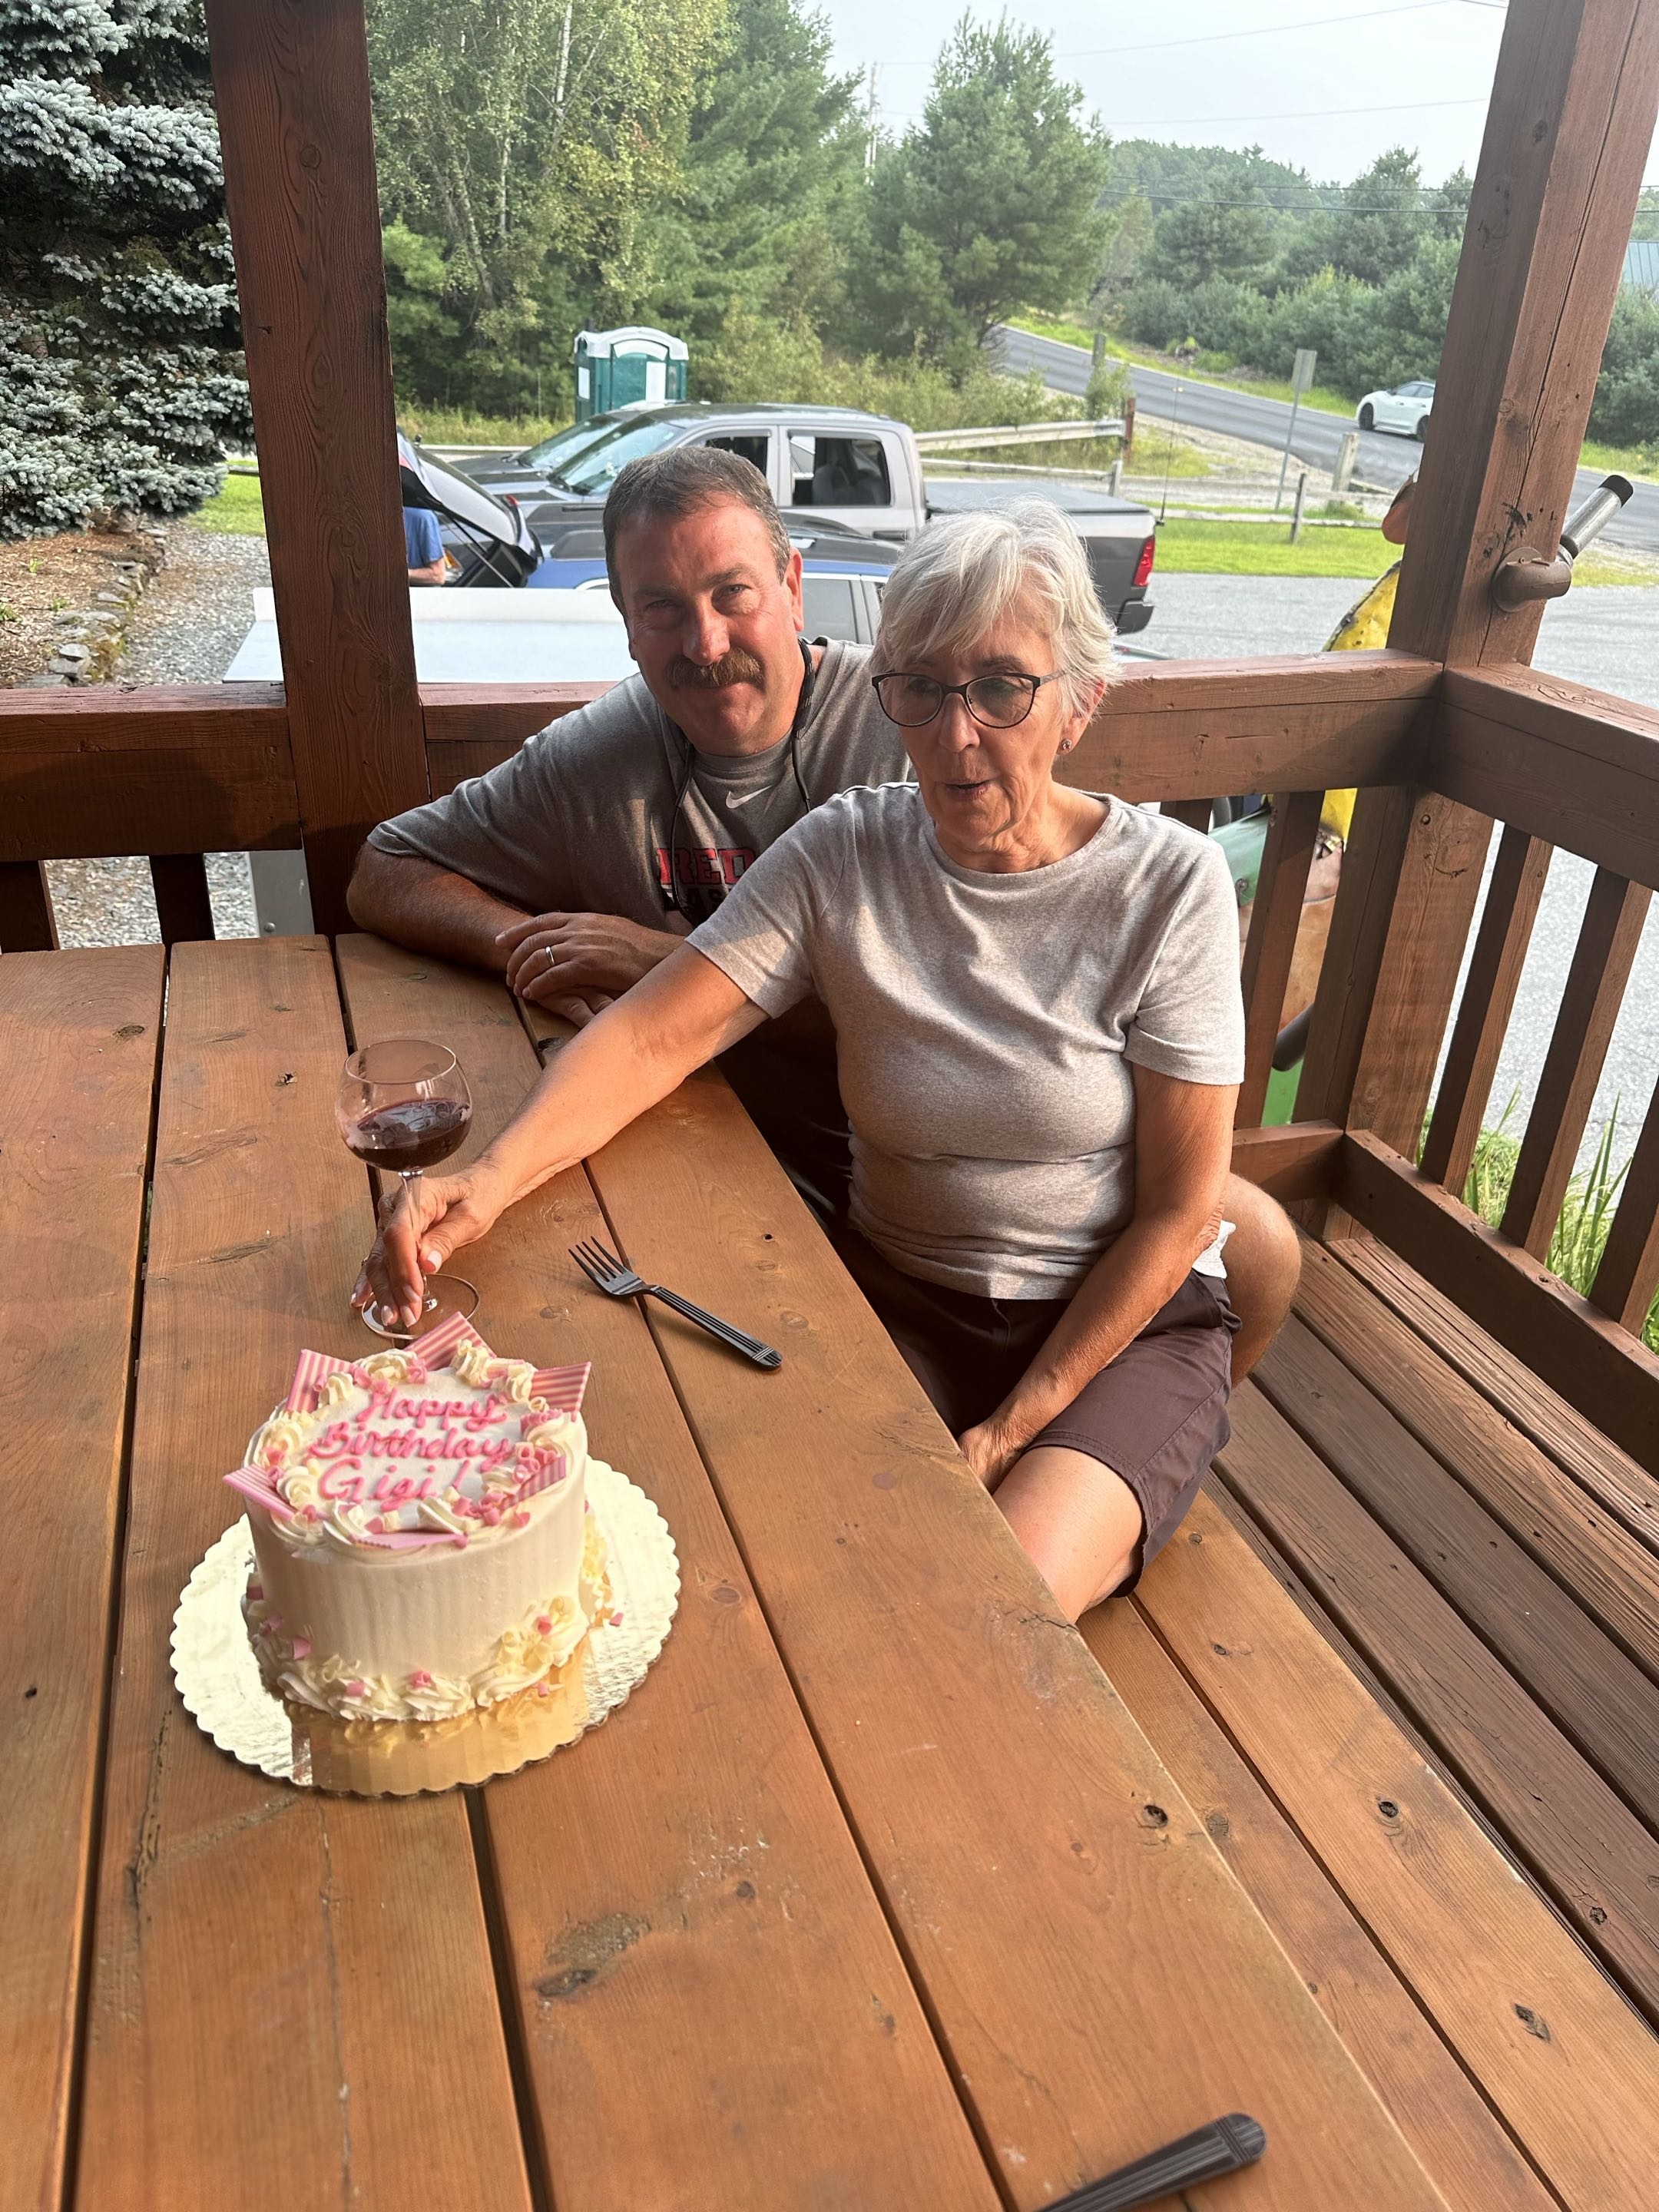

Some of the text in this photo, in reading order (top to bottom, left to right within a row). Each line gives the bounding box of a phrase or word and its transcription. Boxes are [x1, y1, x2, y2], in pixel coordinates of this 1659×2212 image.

[657, 847, 757, 885] RED
[356, 1386, 508, 1432] Happy
[308, 1422, 515, 1472] Birthday
